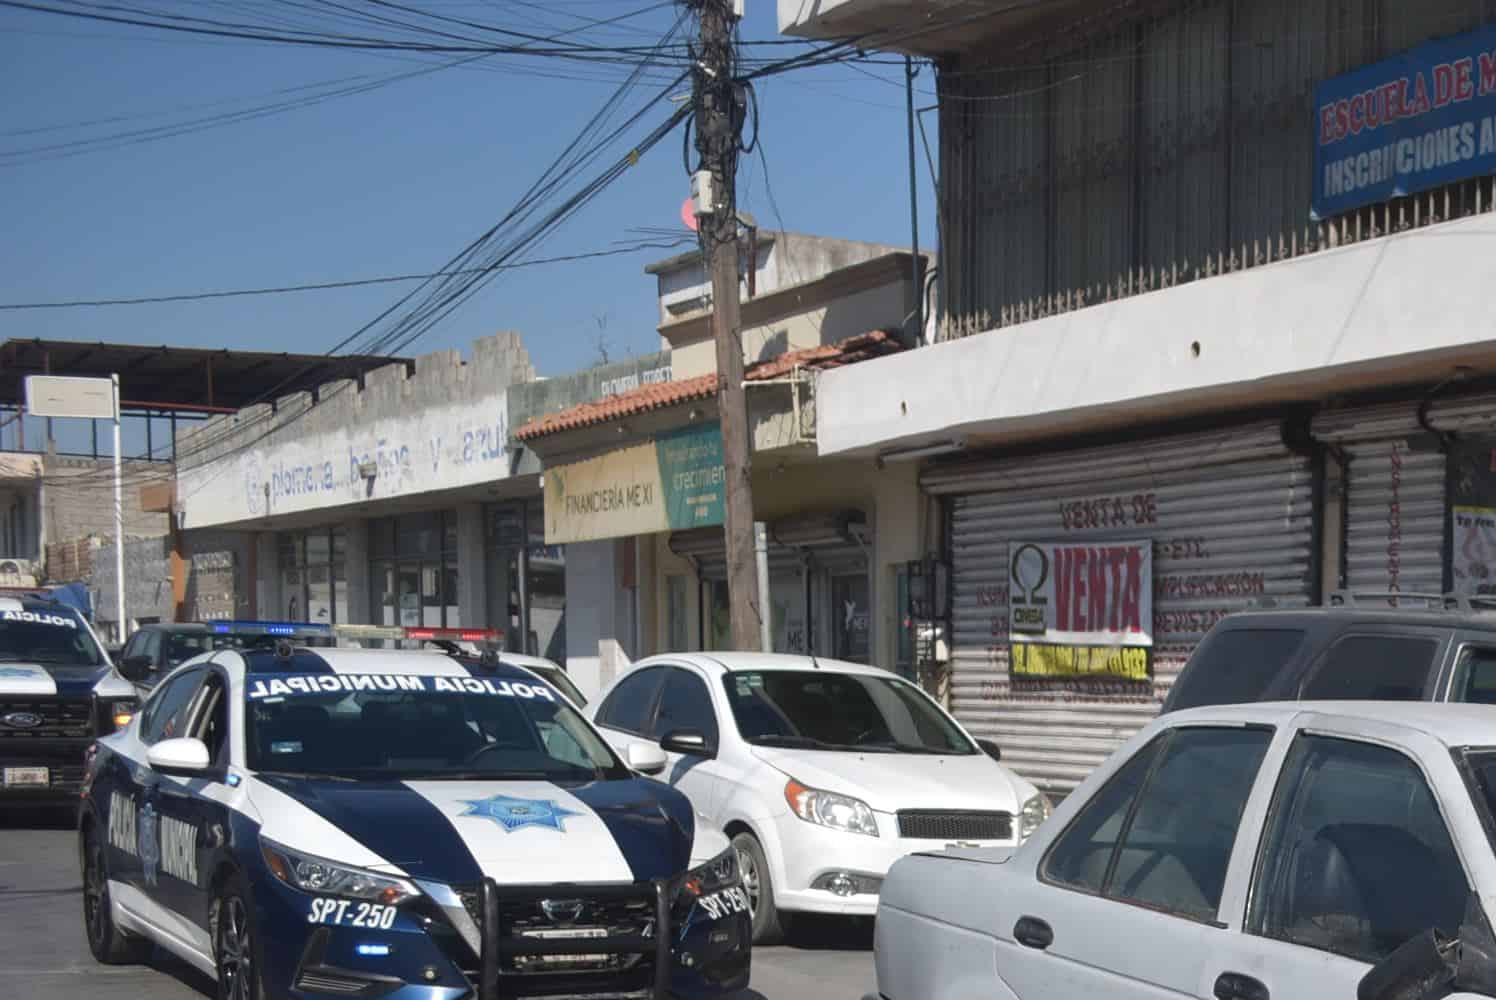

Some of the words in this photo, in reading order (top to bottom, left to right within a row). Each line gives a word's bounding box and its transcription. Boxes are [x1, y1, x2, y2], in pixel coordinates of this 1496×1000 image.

[1320, 71, 1429, 145] ESCUELA
[1431, 56, 1474, 108] DE
[1324, 121, 1475, 198] INSCRICIONES
[1059, 498, 1127, 530] VENTA
[1133, 494, 1158, 524] DE
[1053, 547, 1142, 633] VENTA
[307, 897, 397, 930] SPT-250
